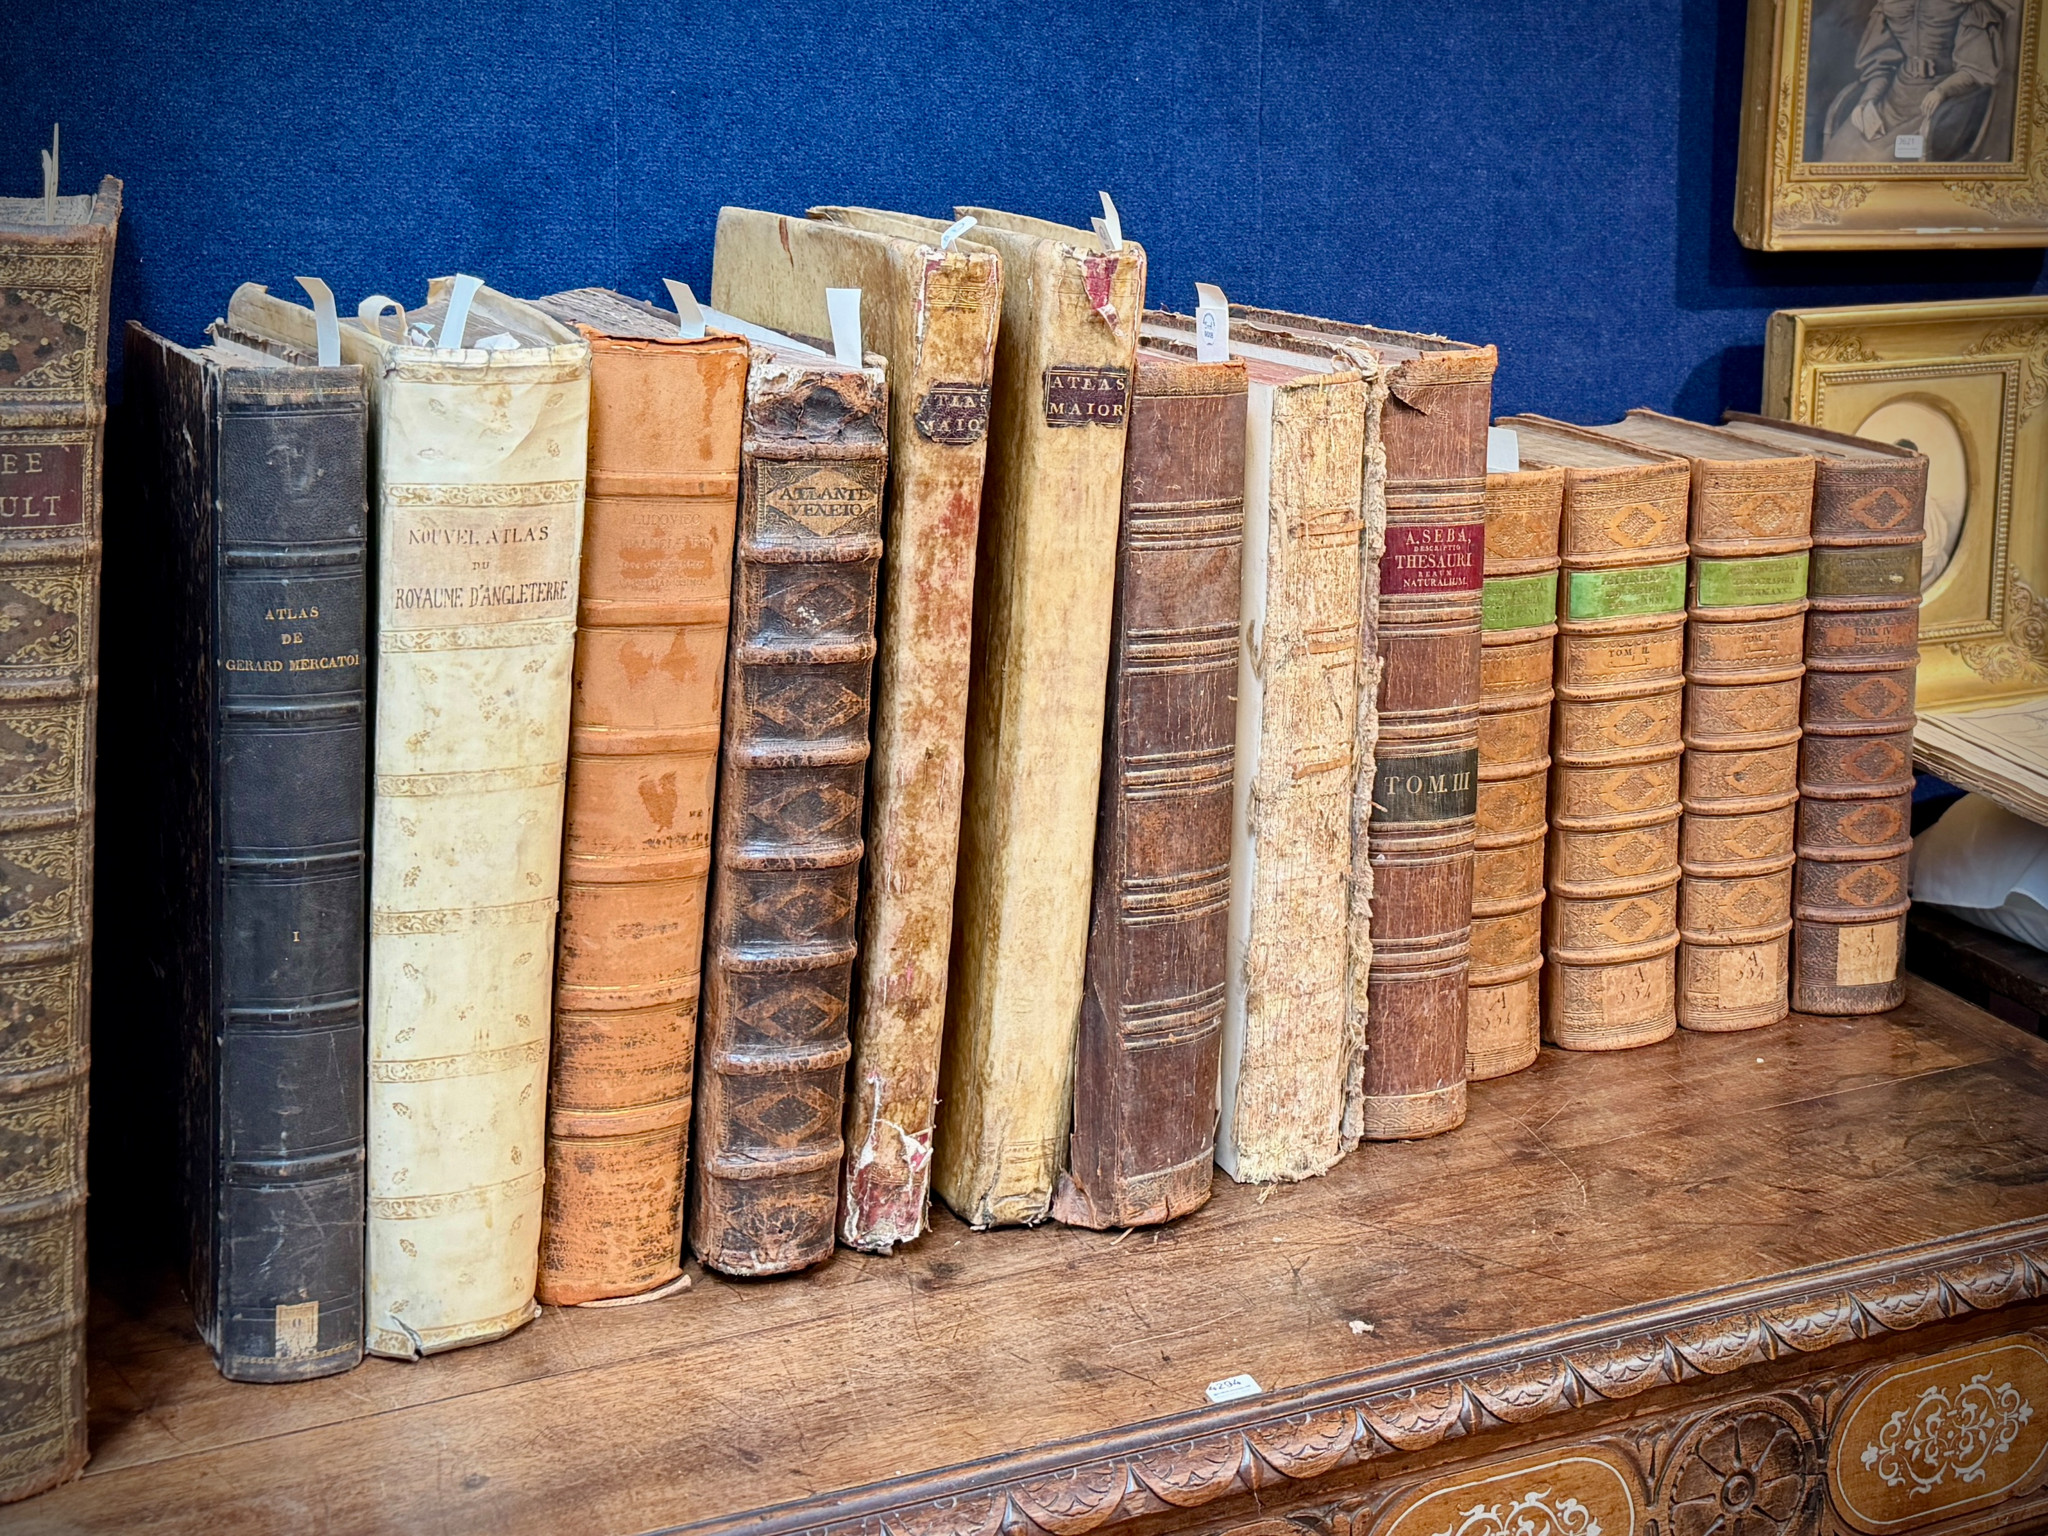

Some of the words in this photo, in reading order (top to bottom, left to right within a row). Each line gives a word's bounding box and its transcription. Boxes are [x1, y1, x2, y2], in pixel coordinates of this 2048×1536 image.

[1051, 375, 1125, 391] ATLAS
[924, 394, 987, 408] TLAS
[1050, 402, 1124, 417] MAIOR
[920, 418, 985, 433] MAIO
[780, 487, 870, 501] ATLANTE
[408, 528, 479, 545] NOUVEL
[486, 526, 549, 544] ATLAS
[472, 561, 490, 571] DU
[1394, 552, 1473, 570] THESAURI
[395, 587, 463, 610] ROYAUME
[469, 579, 568, 608] D'ANGLETERRE
[265, 606, 320, 621] ATLAS
[281, 632, 303, 645] DE
[225, 658, 284, 673] GERARD
[1383, 774, 1448, 795] TOM.
[1451, 771, 1471, 792] III
